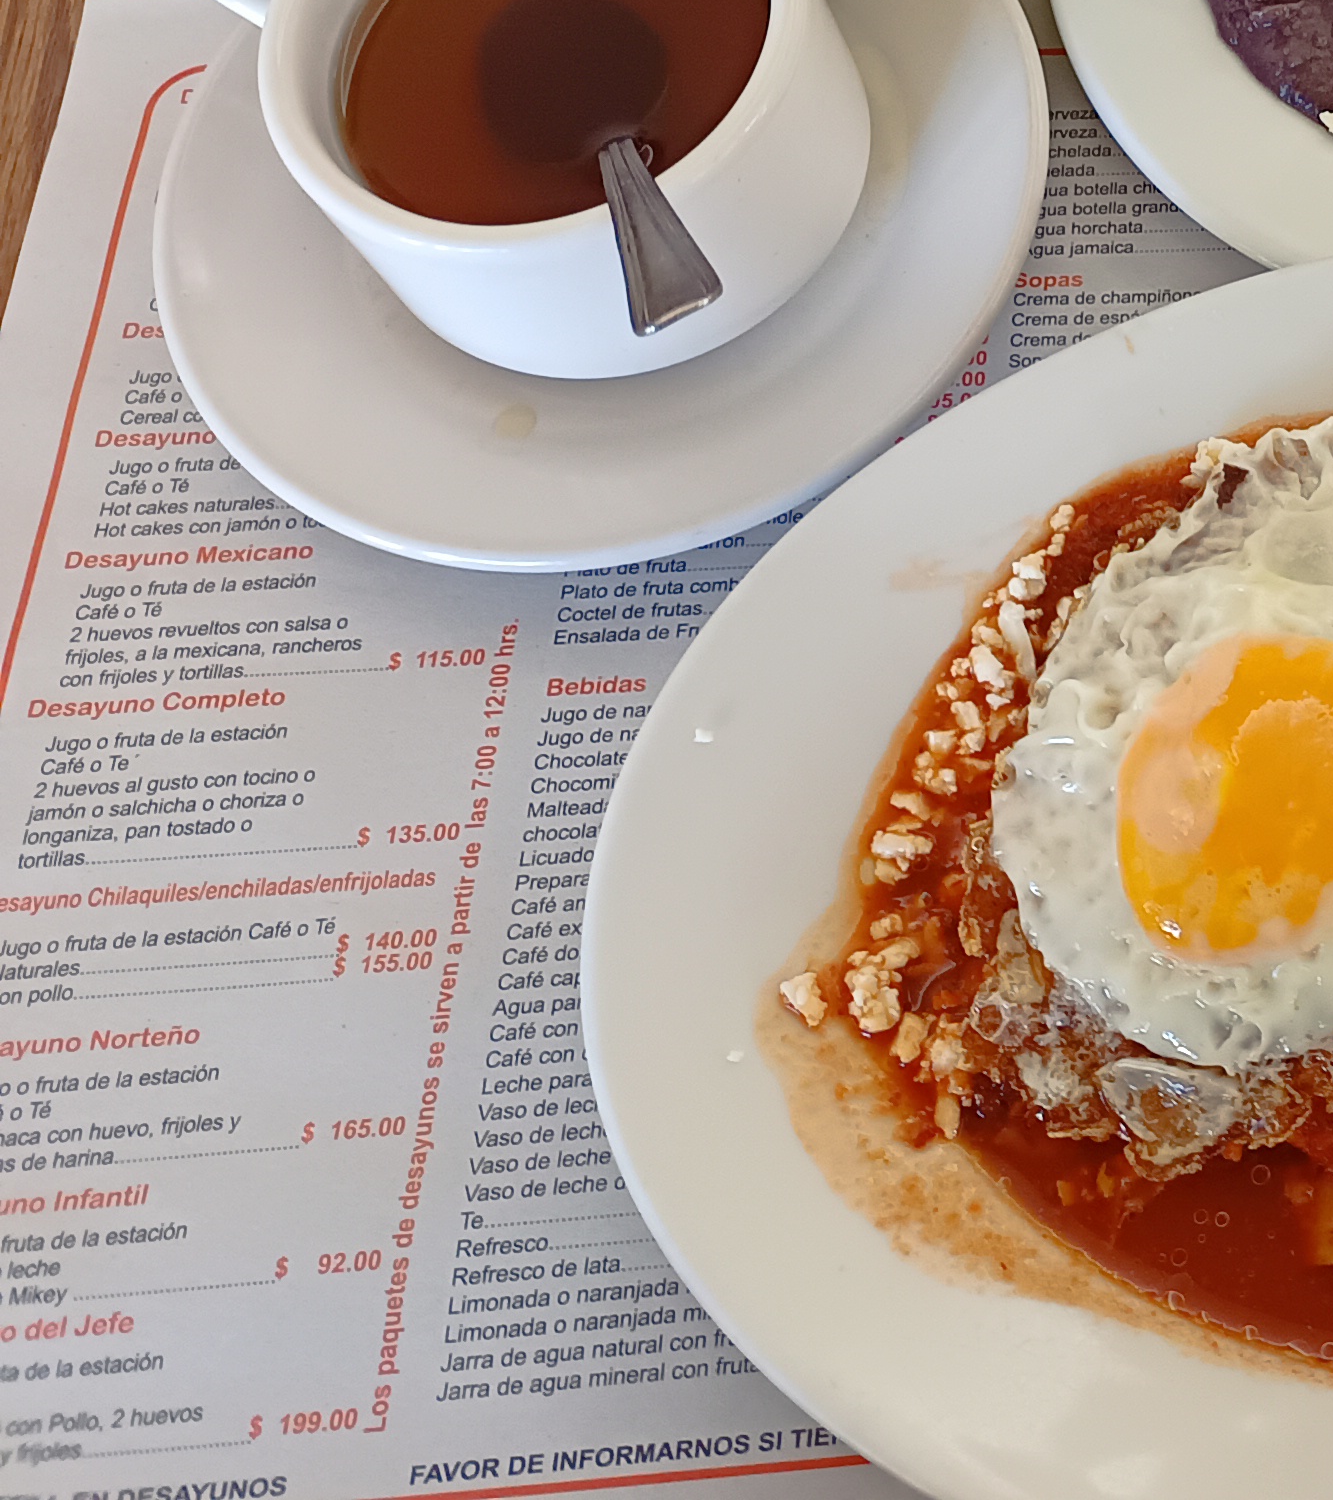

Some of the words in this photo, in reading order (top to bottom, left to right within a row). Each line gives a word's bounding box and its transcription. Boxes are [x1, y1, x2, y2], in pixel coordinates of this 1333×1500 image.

[1074, 182, 1127, 196] botella
[1072, 221, 1142, 235] horchata
[1068, 241, 1133, 258] jamaica
[1015, 272, 1082, 291] Sopas
[1014, 293, 1069, 306] Crema
[1075, 292, 1095, 305] de
[129, 370, 172, 387] Jugo
[120, 409, 178, 425] Cereal
[95, 429, 216, 450] Desayuno
[100, 502, 131, 516] Hot
[136, 500, 188, 515] cakes
[194, 496, 275, 513] naturales
[65, 552, 188, 571] Desayuno
[196, 544, 313, 563] Mexicano
[80, 584, 125, 602] Jugo
[130, 585, 142, 596] o
[148, 580, 187, 596] fruta
[193, 578, 215, 593] de
[221, 578, 236, 592] la
[242, 573, 316, 591] estación
[561, 585, 608, 599] Plato
[614, 582, 636, 597] de
[643, 581, 683, 595] fruta
[76, 604, 118, 620] Café
[124, 607, 136, 618] o
[142, 602, 162, 617] Té
[70, 627, 82, 642] 2
[87, 627, 153, 642] huevos
[158, 621, 240, 638] revueltos
[246, 621, 278, 634] con
[284, 616, 331, 632] salsa
[337, 618, 348, 629] o
[494, 619, 518, 656] hrs.
[554, 627, 640, 645] Ensalada
[647, 625, 669, 640] de
[66, 648, 128, 668] frijoles,
[134, 649, 147, 662] a
[152, 646, 169, 661] la
[174, 642, 265, 659] mexicana,
[272, 637, 362, 654] rancheros
[386, 652, 401, 671] $
[417, 649, 485, 668] 115.00
[484, 664, 510, 718] 12:00
[547, 676, 646, 696] Bebidas
[28, 698, 154, 720] Desayuno
[163, 689, 285, 712] Completo
[485, 726, 500, 737] a
[471, 746, 496, 790] 7:00
[535, 751, 628, 770] Chocolate
[464, 798, 488, 828] las
[23, 825, 117, 848] longaniza,
[125, 825, 160, 843] pan
[167, 817, 235, 836] tostado
[241, 820, 252, 832] o
[18, 850, 85, 869] tortillas
[357, 827, 370, 847] $
[387, 823, 460, 844] 135.00
[460, 843, 481, 868] de
[0, 892, 82, 914] esayuno
[88, 869, 436, 908] Chilaquiles/enchiladas/enfrijoladas
[451, 876, 475, 934] partir
[336, 934, 349, 954] $
[366, 929, 437, 950] 140.00
[447, 943, 462, 954] a
[27, 984, 73, 1007] pollo
[430, 963, 459, 1033] sirven
[90, 1026, 200, 1050] Norteño
[427, 1042, 445, 1068] se
[482, 1075, 542, 1095] Leche
[548, 1073, 592, 1094] para
[301, 1122, 315, 1144] $
[332, 1116, 405, 1140] 165.00
[399, 1077, 440, 1209] desayunos
[22, 1153, 46, 1171] de
[53, 1149, 114, 1168] harina
[470, 1157, 518, 1175] Vaso
[525, 1153, 550, 1170] de
[557, 1148, 612, 1168] leche
[54, 1184, 149, 1211] Infantil
[392, 1219, 415, 1248] de
[461, 1211, 483, 1230] Te
[456, 1237, 548, 1258] Refresco
[7, 1260, 60, 1279] leche
[9, 1286, 67, 1307] Mikey
[275, 1256, 288, 1280] $
[318, 1250, 381, 1274] 92.00
[452, 1265, 545, 1286] Refresco
[552, 1259, 577, 1278] de
[584, 1256, 620, 1274] lata
[448, 1289, 550, 1315] Limonada
[558, 1291, 570, 1305] o
[577, 1278, 678, 1303] naranjada
[25, 1316, 67, 1341] del
[74, 1311, 134, 1336] Jefe
[378, 1257, 409, 1375] paquetes
[436, 1382, 490, 1402] Jarra
[497, 1376, 523, 1396] de
[530, 1374, 581, 1396] agua
[589, 1363, 665, 1387] mineral
[672, 1363, 708, 1379] con
[364, 1385, 391, 1433] Los
[249, 1415, 263, 1440] $
[281, 1408, 358, 1434] 199.00
[410, 1458, 499, 1485] FAVOR
[508, 1454, 544, 1476] DE
[552, 1435, 749, 1471] INFORMARNOS
[759, 1432, 782, 1451] SI
